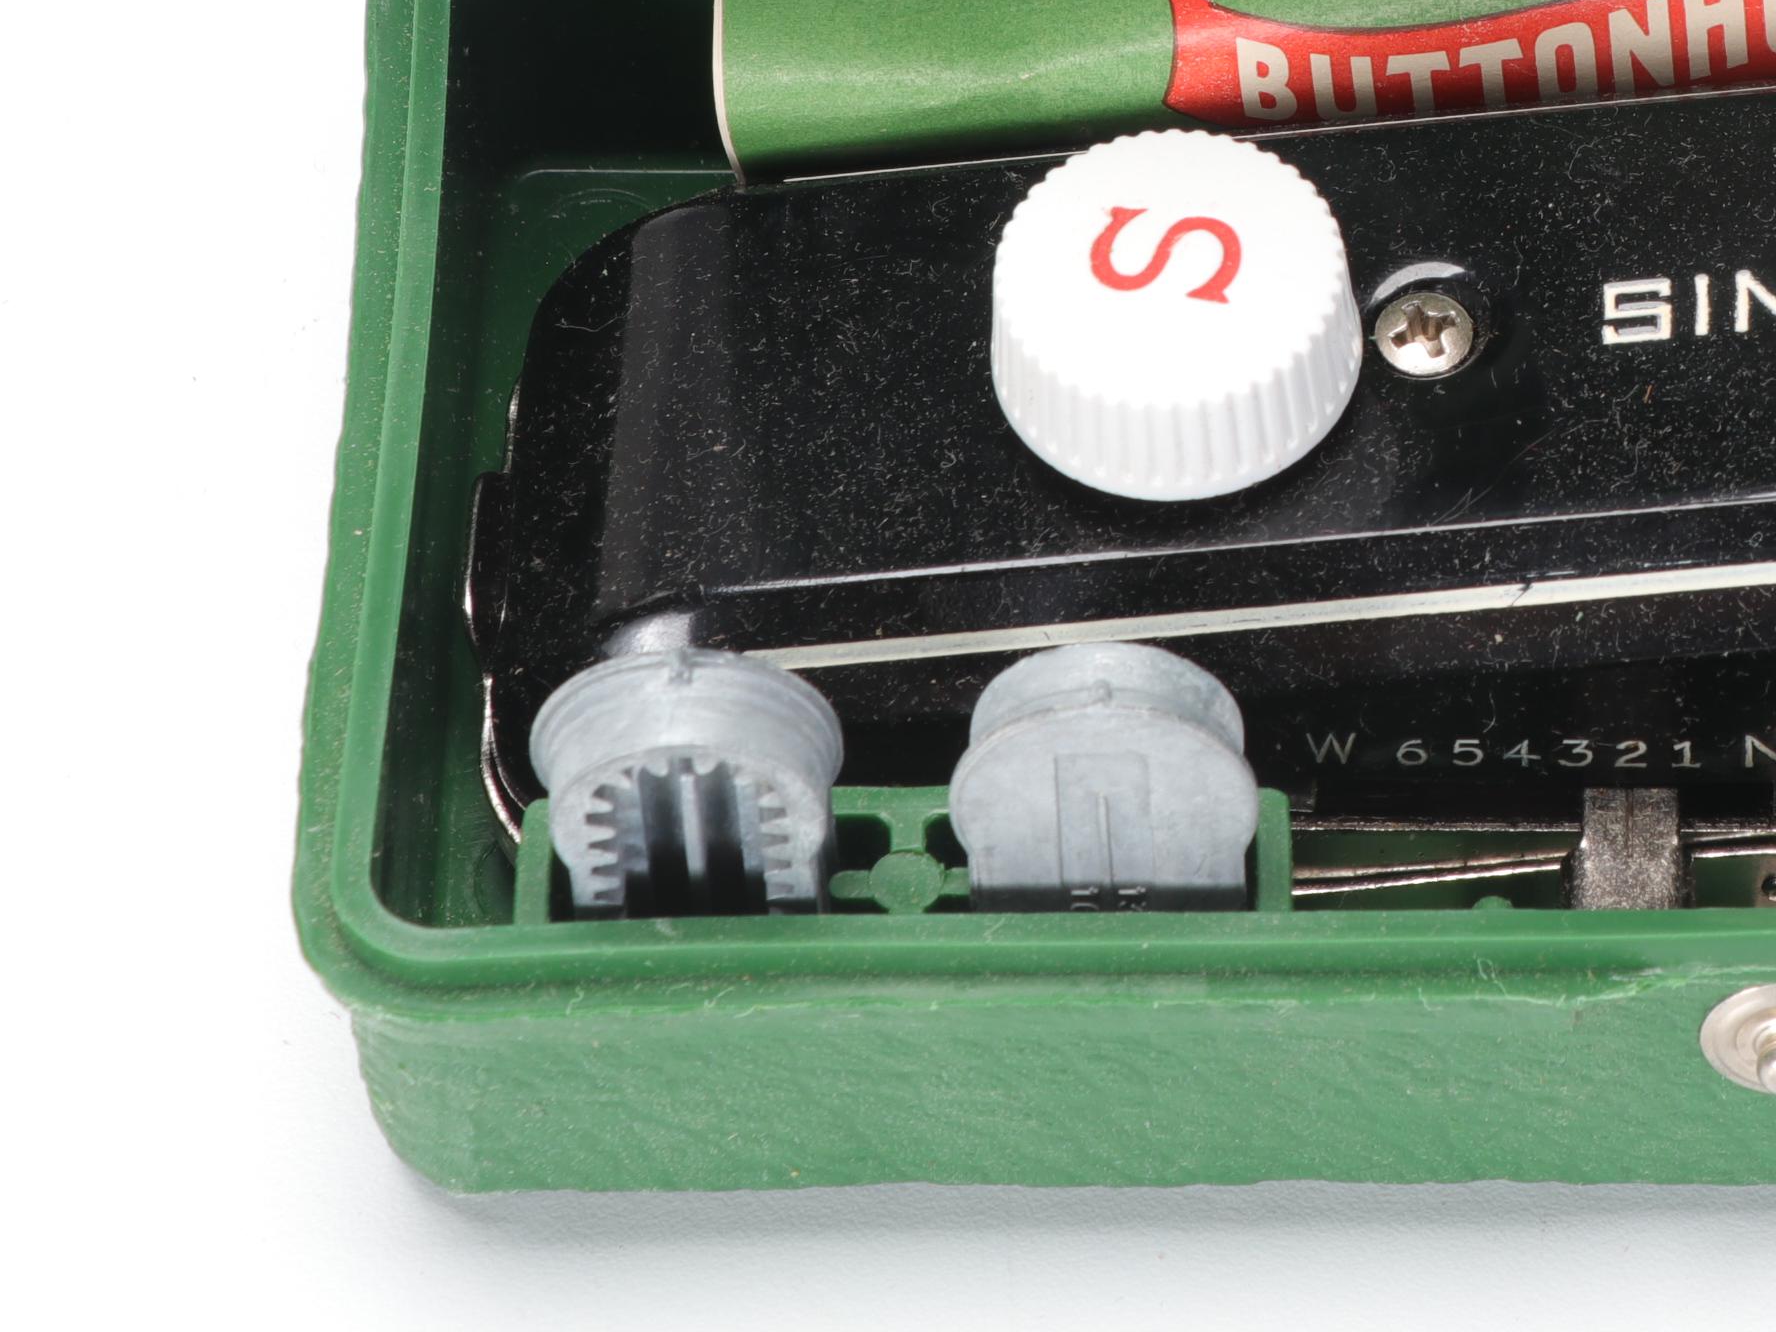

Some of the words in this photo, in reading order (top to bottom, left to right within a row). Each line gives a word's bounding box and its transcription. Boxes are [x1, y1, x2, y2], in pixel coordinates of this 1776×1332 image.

[1090, 206, 1243, 305] S
[1305, 731, 1358, 766] W
[1395, 737, 1703, 769] 654321
